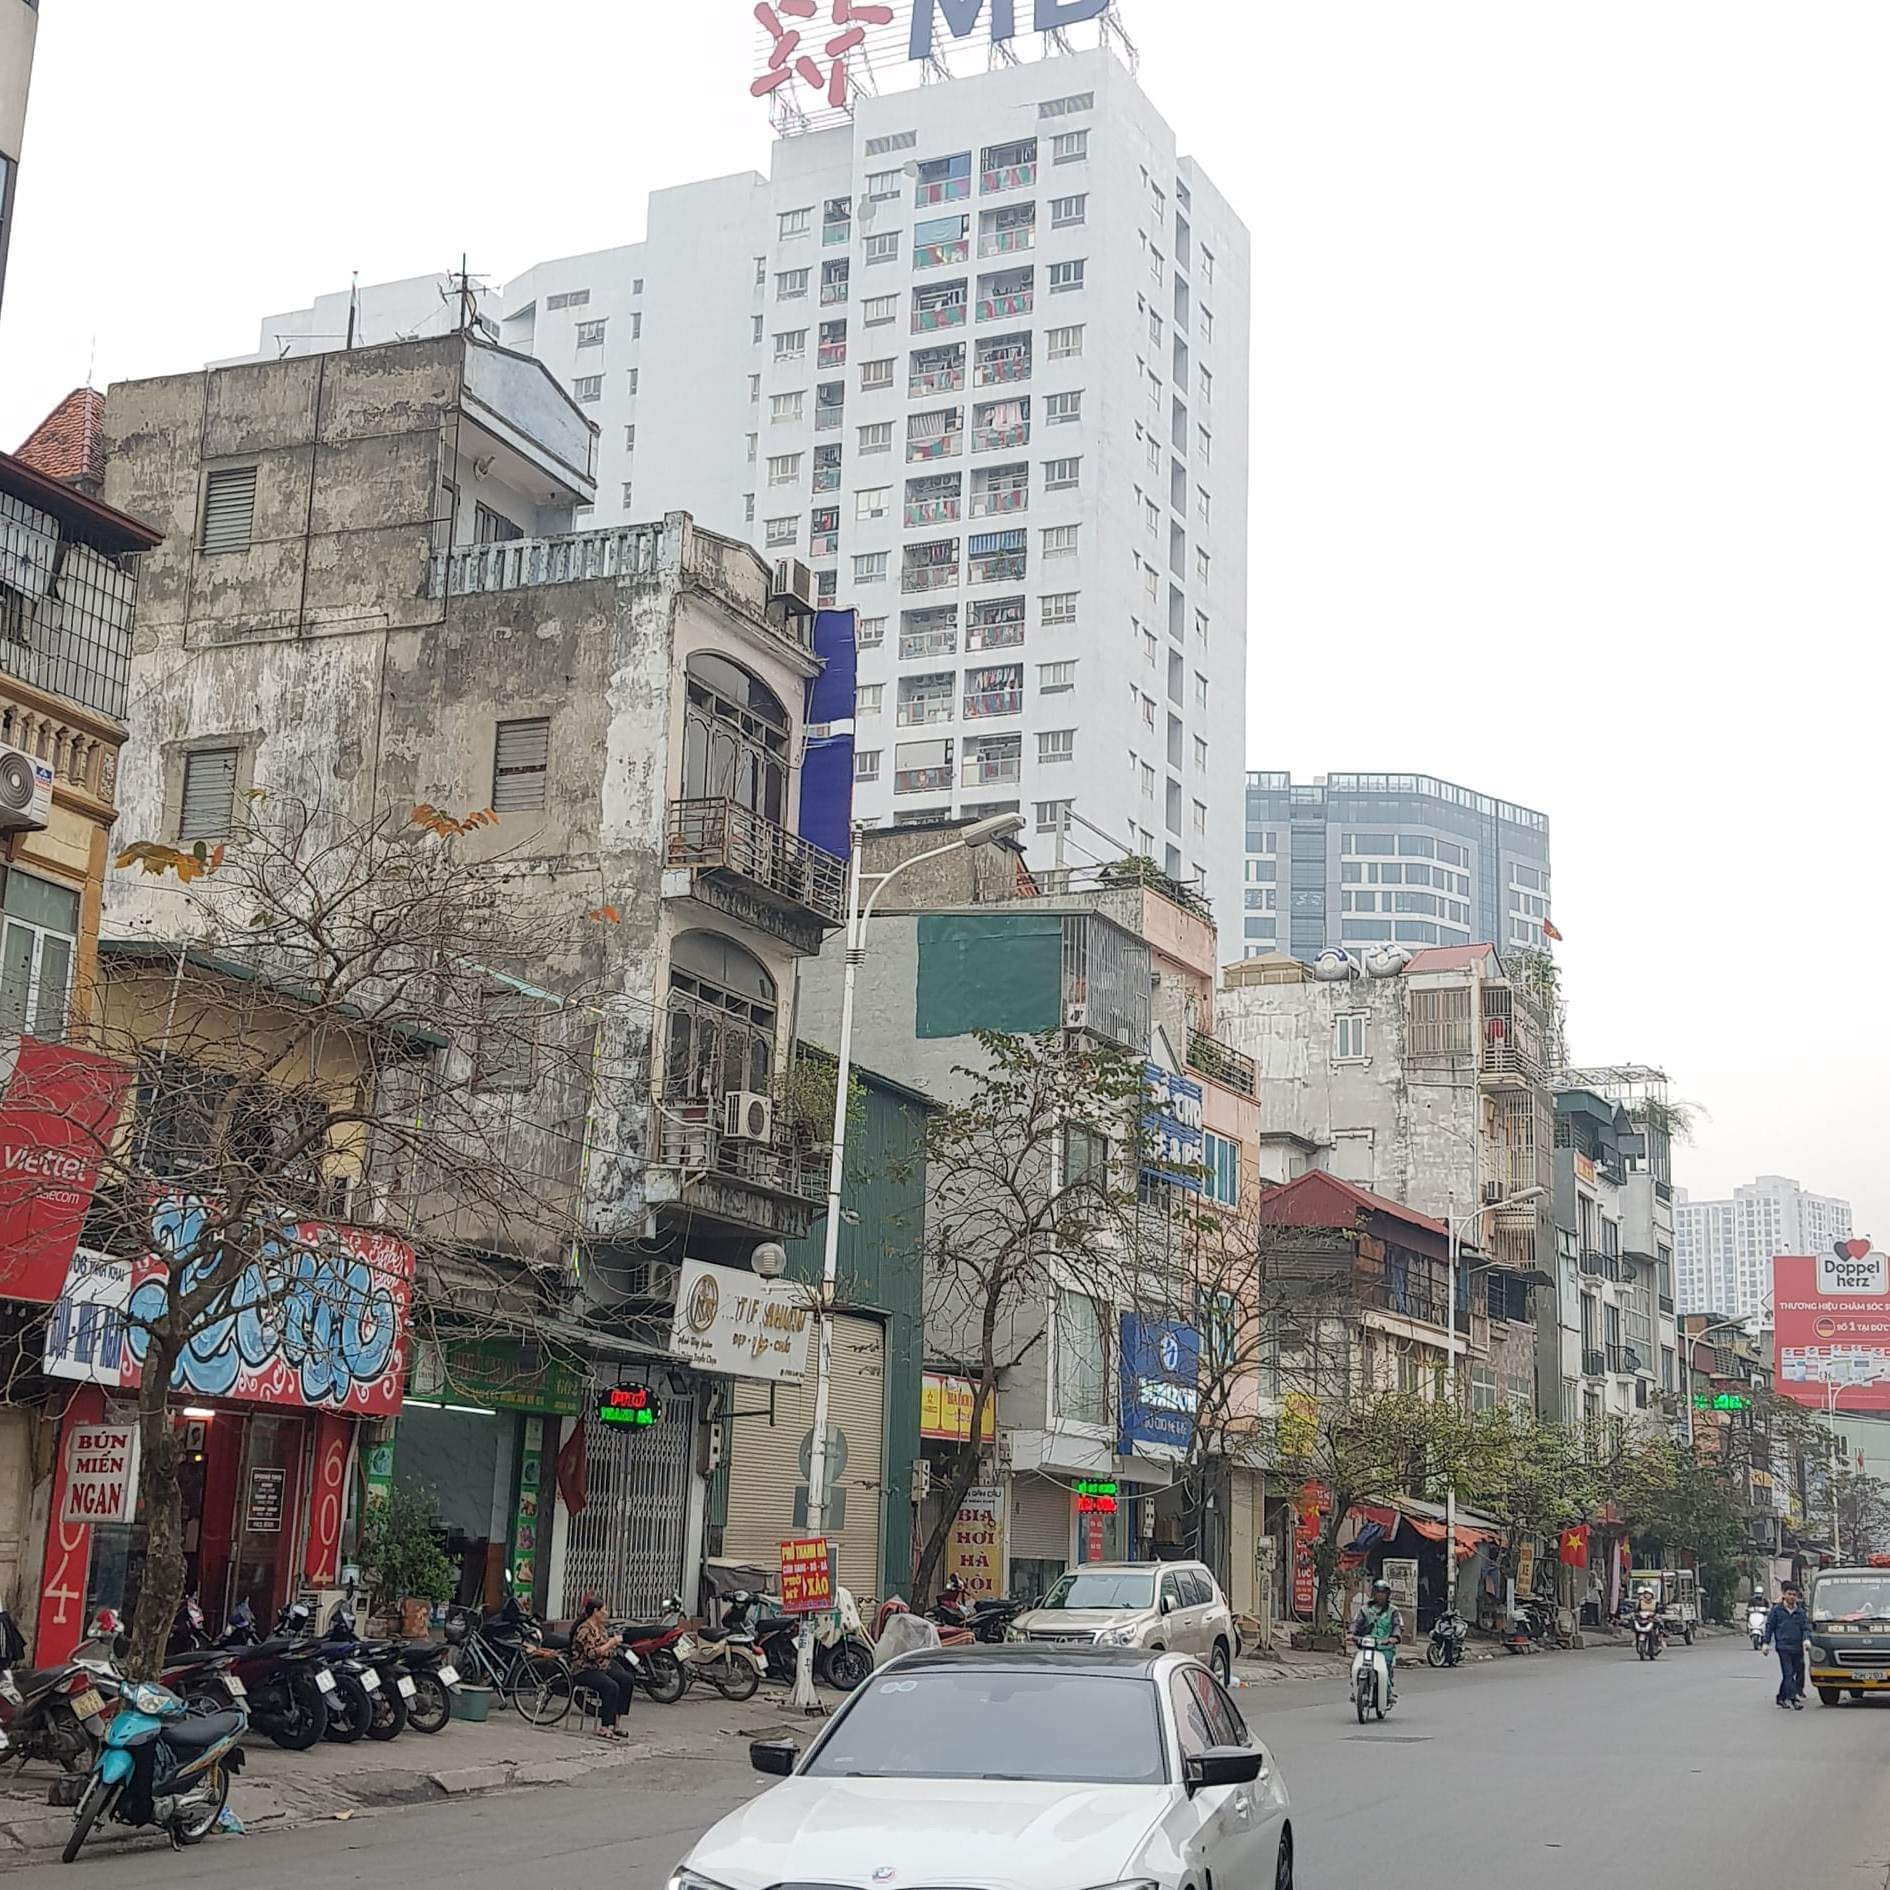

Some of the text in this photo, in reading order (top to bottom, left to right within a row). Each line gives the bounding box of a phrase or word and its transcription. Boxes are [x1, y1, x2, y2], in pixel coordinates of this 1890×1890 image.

[1824, 1260, 1880, 1277] Doppel
[1836, 1274, 1871, 1288] herz
[1848, 1321, 1856, 1332] 1
[77, 1431, 128, 1449] BÚN
[75, 1450, 124, 1474] MIẾN
[69, 1482, 122, 1515] NGAN
[958, 1508, 993, 1522] BIA
[956, 1530, 994, 1545] HƠI
[959, 1551, 990, 1568] HÀ
[807, 1572, 829, 1596] XÀO
